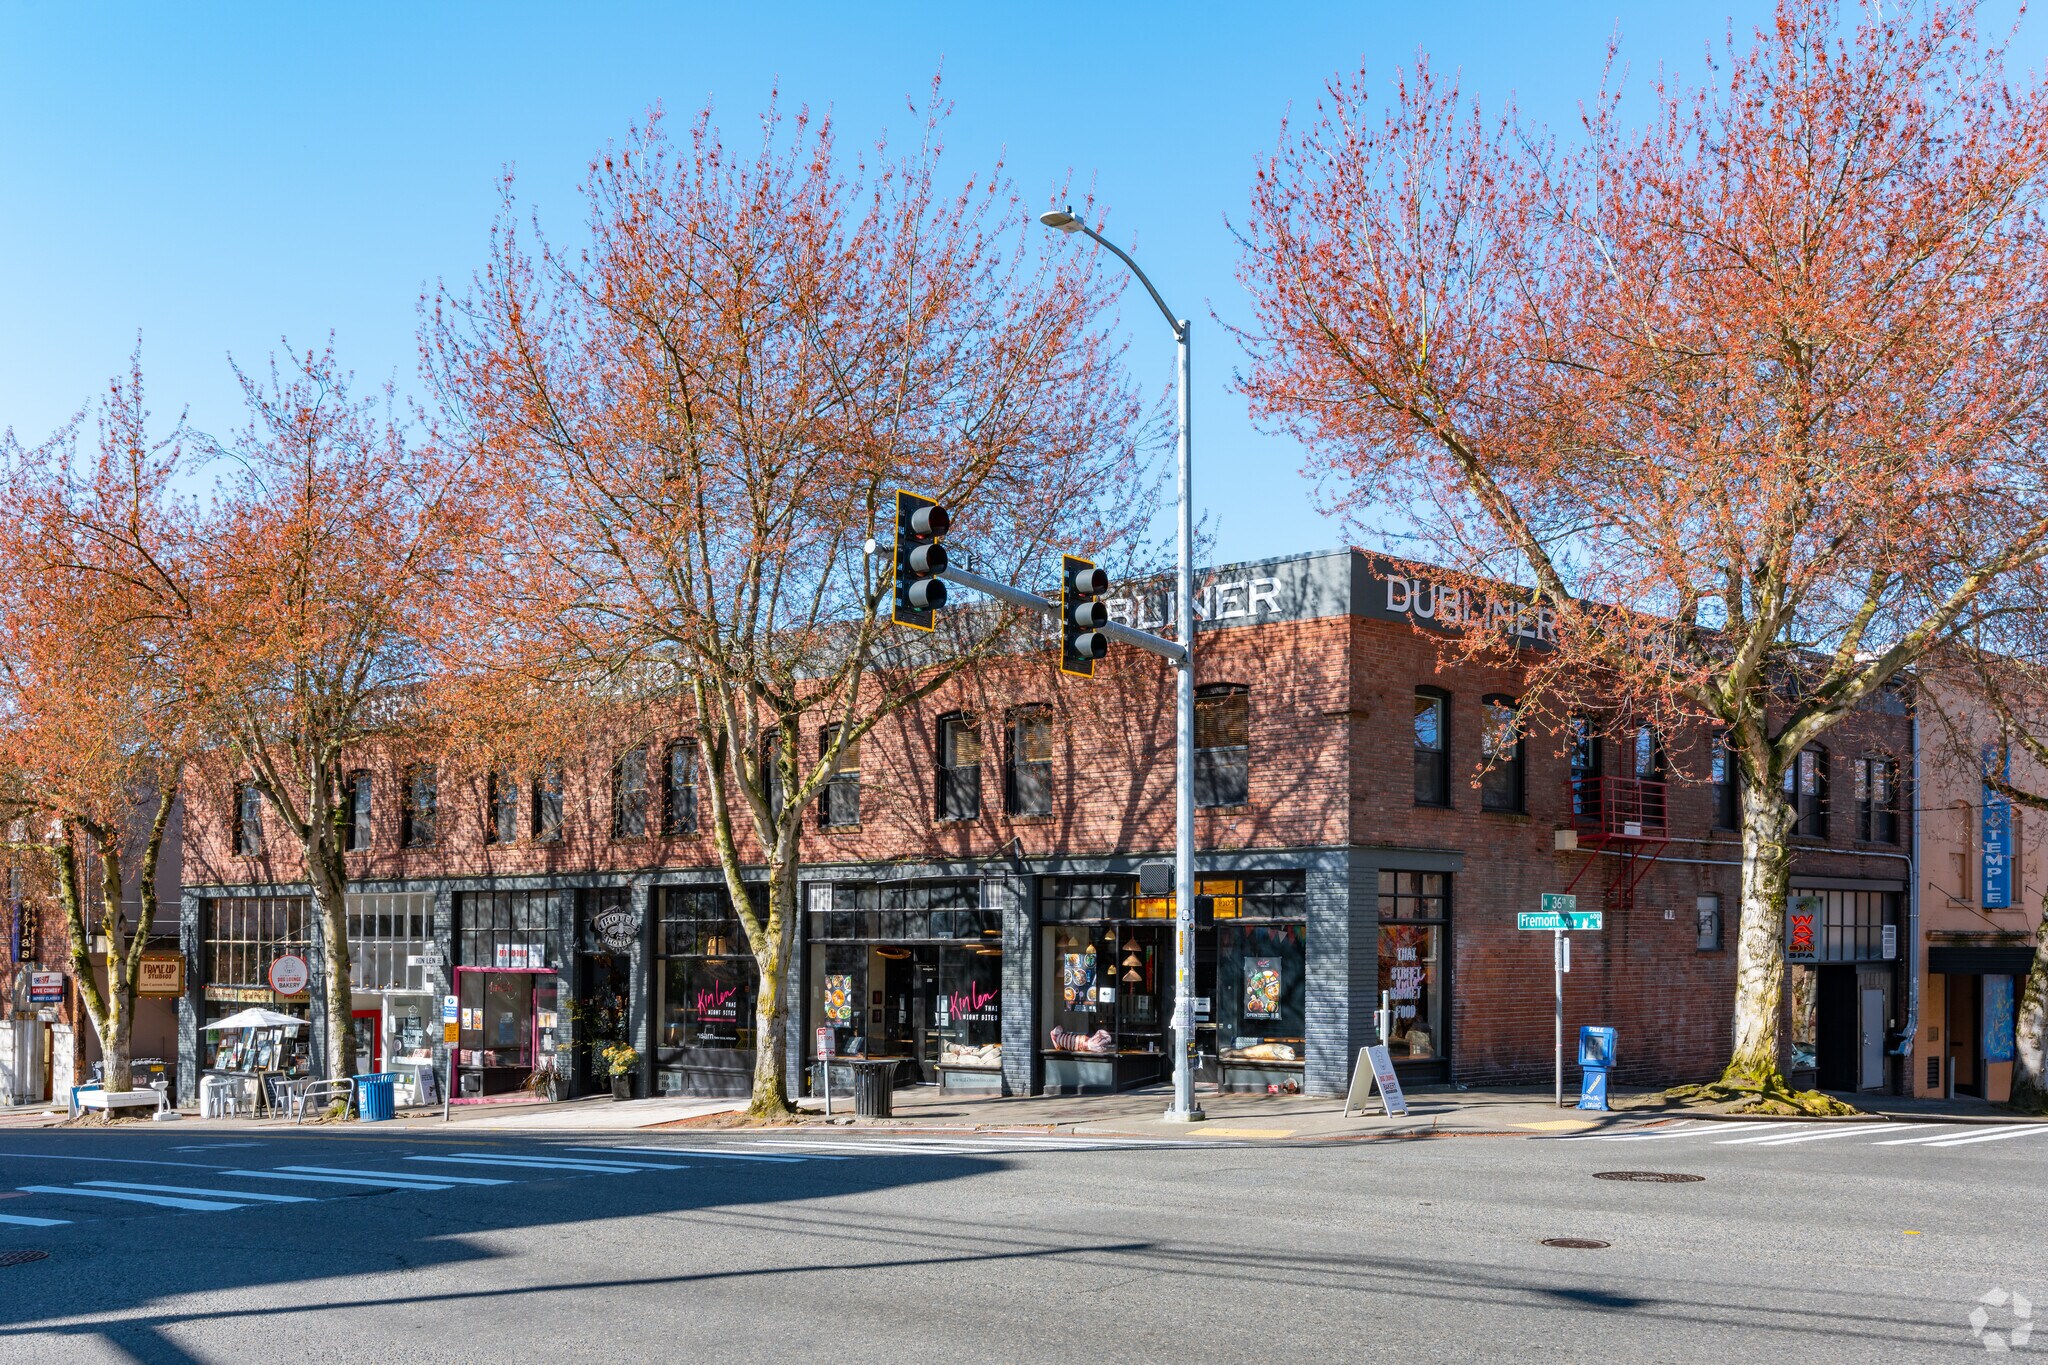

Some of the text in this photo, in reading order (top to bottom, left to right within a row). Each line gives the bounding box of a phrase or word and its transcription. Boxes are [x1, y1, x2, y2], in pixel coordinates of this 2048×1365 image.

[1072, 577, 1283, 632] BLINER
[1986, 830, 2002, 904] TEMPLE
[1543, 898, 1548, 907] N
[1552, 896, 1567, 909] 36th
[600, 914, 637, 928] HOTEL
[1521, 914, 1560, 927] Fremont
[1564, 918, 1577, 926] Ave
[1788, 945, 1815, 953] ON
[426, 957, 436, 965] LEN
[1395, 1004, 1416, 1019] FOOD
